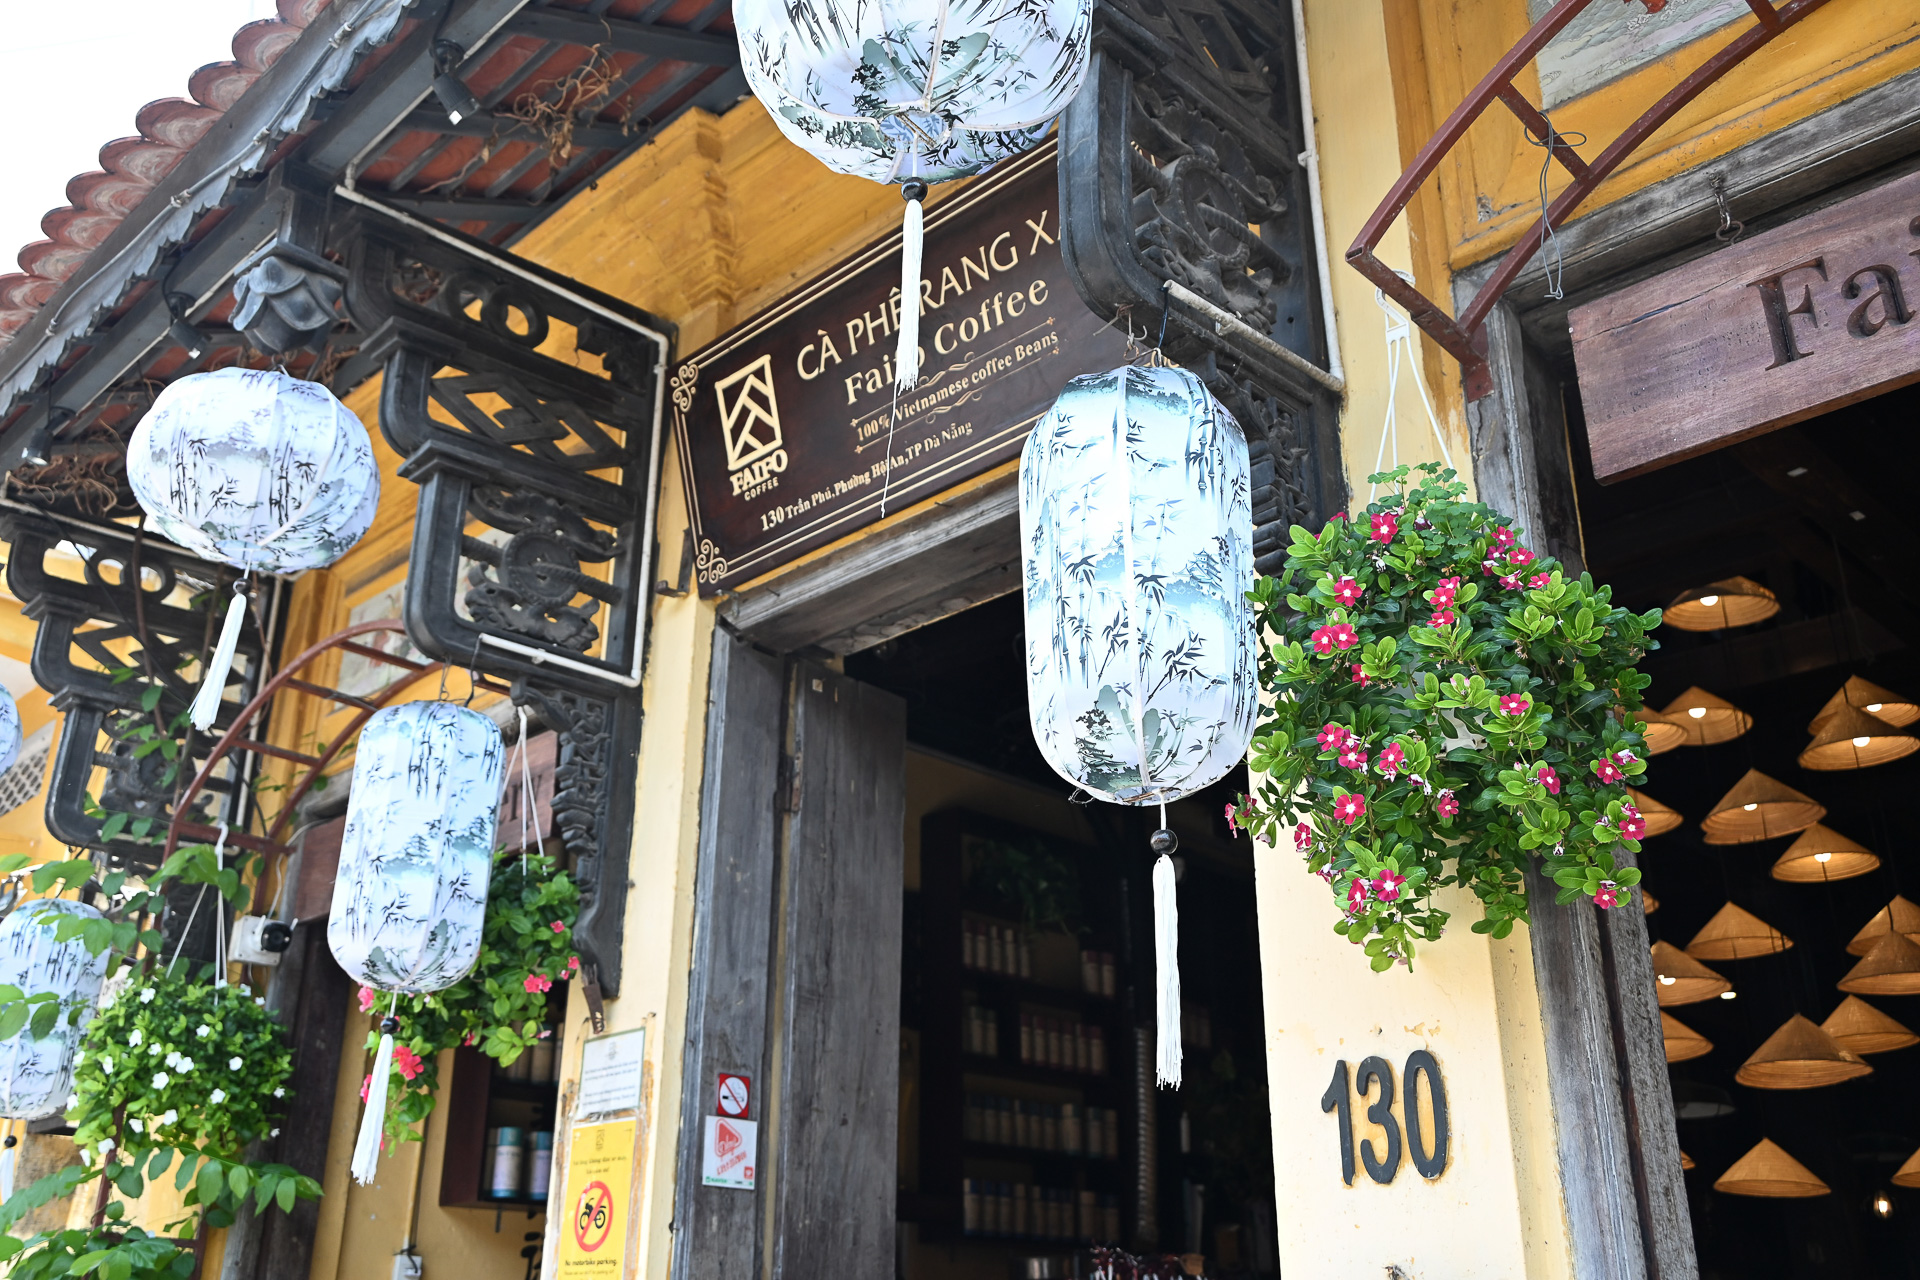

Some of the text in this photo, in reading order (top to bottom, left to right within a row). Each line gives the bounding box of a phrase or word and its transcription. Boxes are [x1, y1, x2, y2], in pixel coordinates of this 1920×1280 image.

[796, 210, 1061, 381] CÀ PHÊ RANG X
[933, 278, 1049, 355] Coffee
[857, 331, 1059, 442] 100% Vietnamese coffee Beans
[730, 449, 789, 497] FAIFO
[744, 477, 779, 502] COFFEE
[760, 506, 785, 531] 130
[1321, 1050, 1448, 1186] 130
